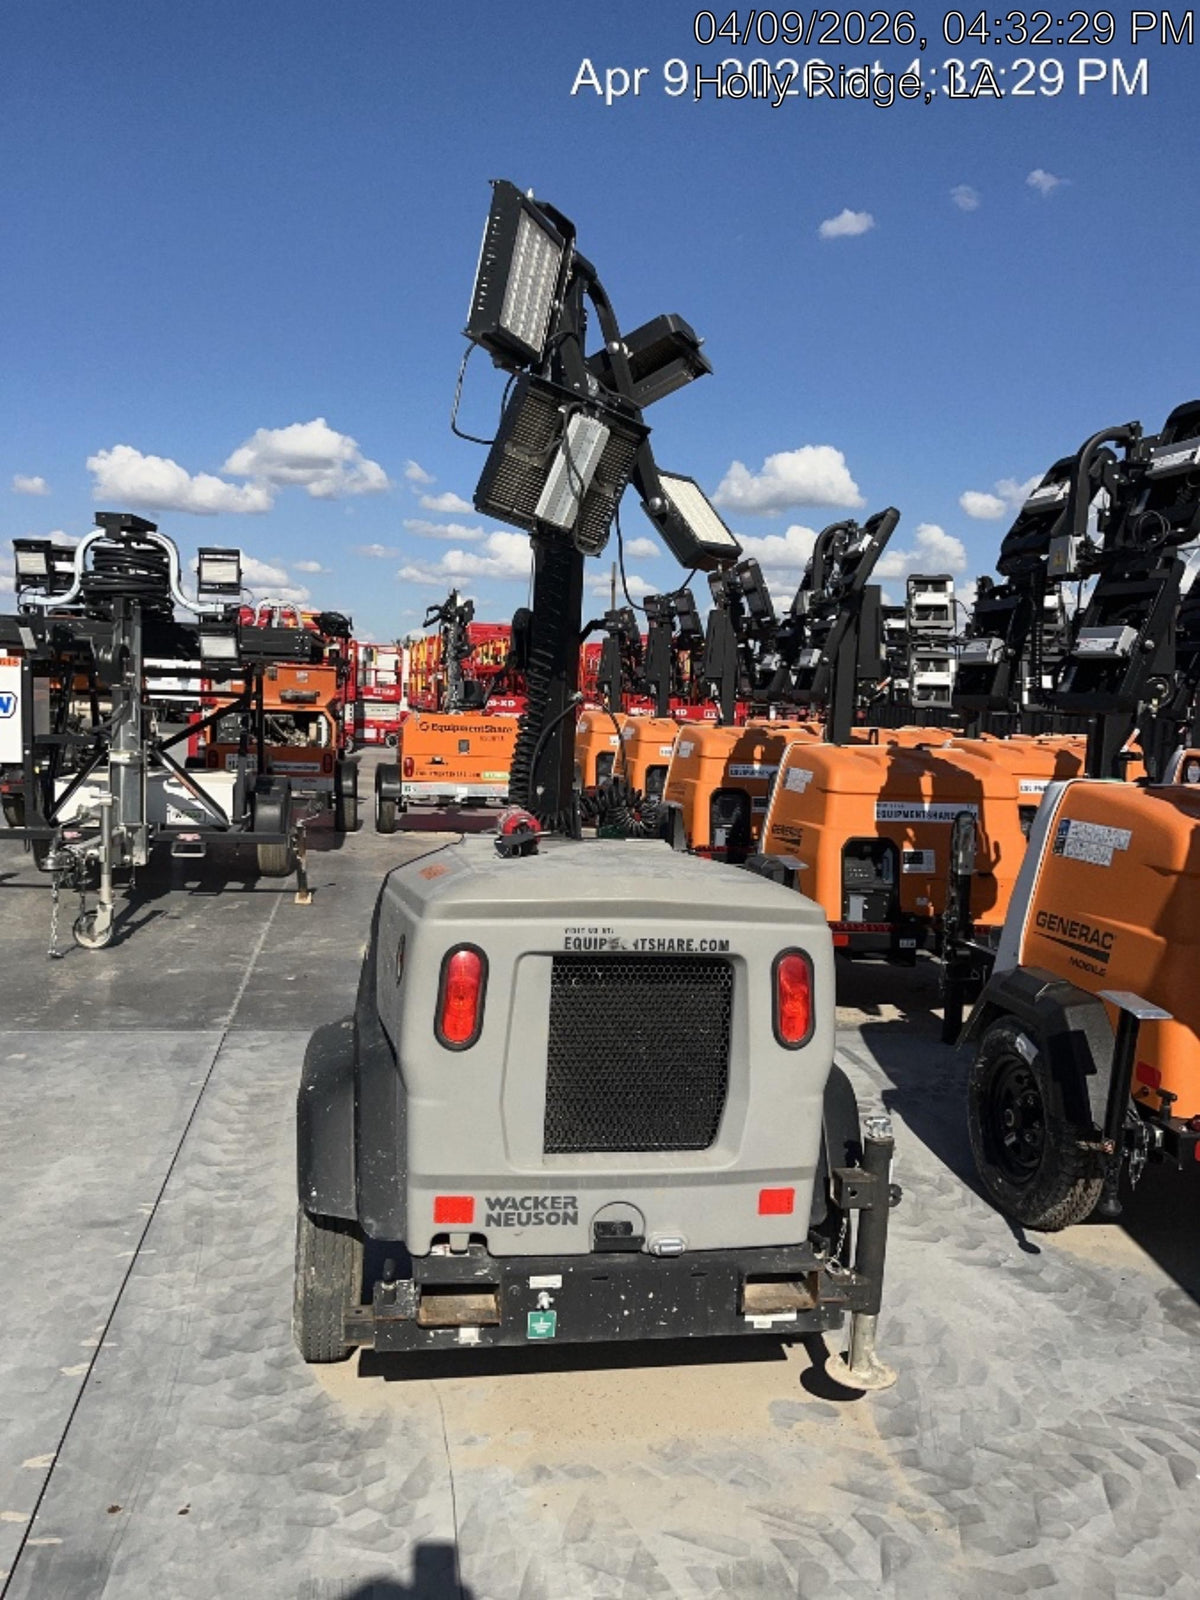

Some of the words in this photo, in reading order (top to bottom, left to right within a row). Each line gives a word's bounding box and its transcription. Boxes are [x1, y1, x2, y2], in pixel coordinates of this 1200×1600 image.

[877, 809, 977, 821] EQUIPMENTSHAREM
[1036, 910, 1114, 950] GENERAC
[564, 936, 731, 952] EQUIPTSHARE.COM
[485, 1195, 579, 1211] WACKER
[485, 1211, 579, 1229] NEUSON
